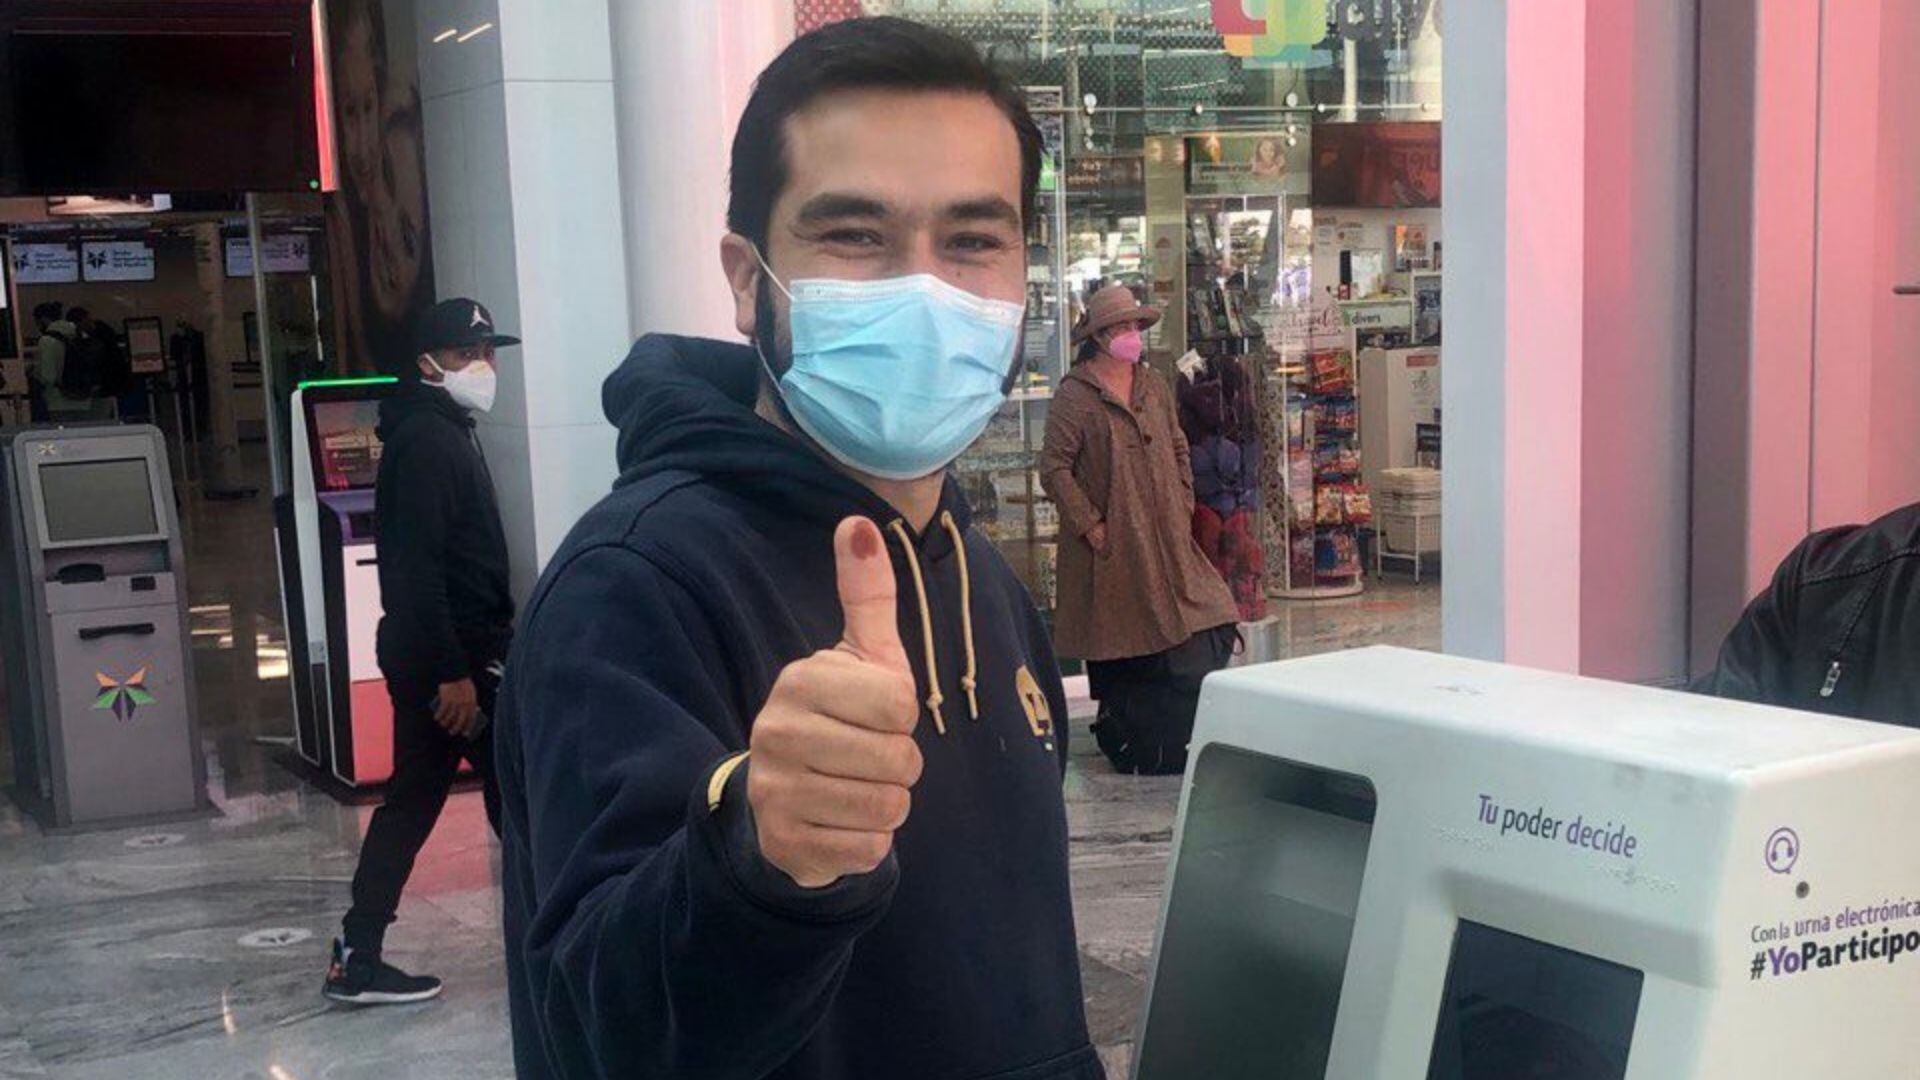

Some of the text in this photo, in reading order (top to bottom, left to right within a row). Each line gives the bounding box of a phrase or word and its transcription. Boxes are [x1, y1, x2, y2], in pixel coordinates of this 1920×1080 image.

[1478, 794, 1637, 858] Tu poder decide
[1751, 897, 1920, 943] Con la urna electrónica
[1751, 926, 1920, 980] #YoParticipo
